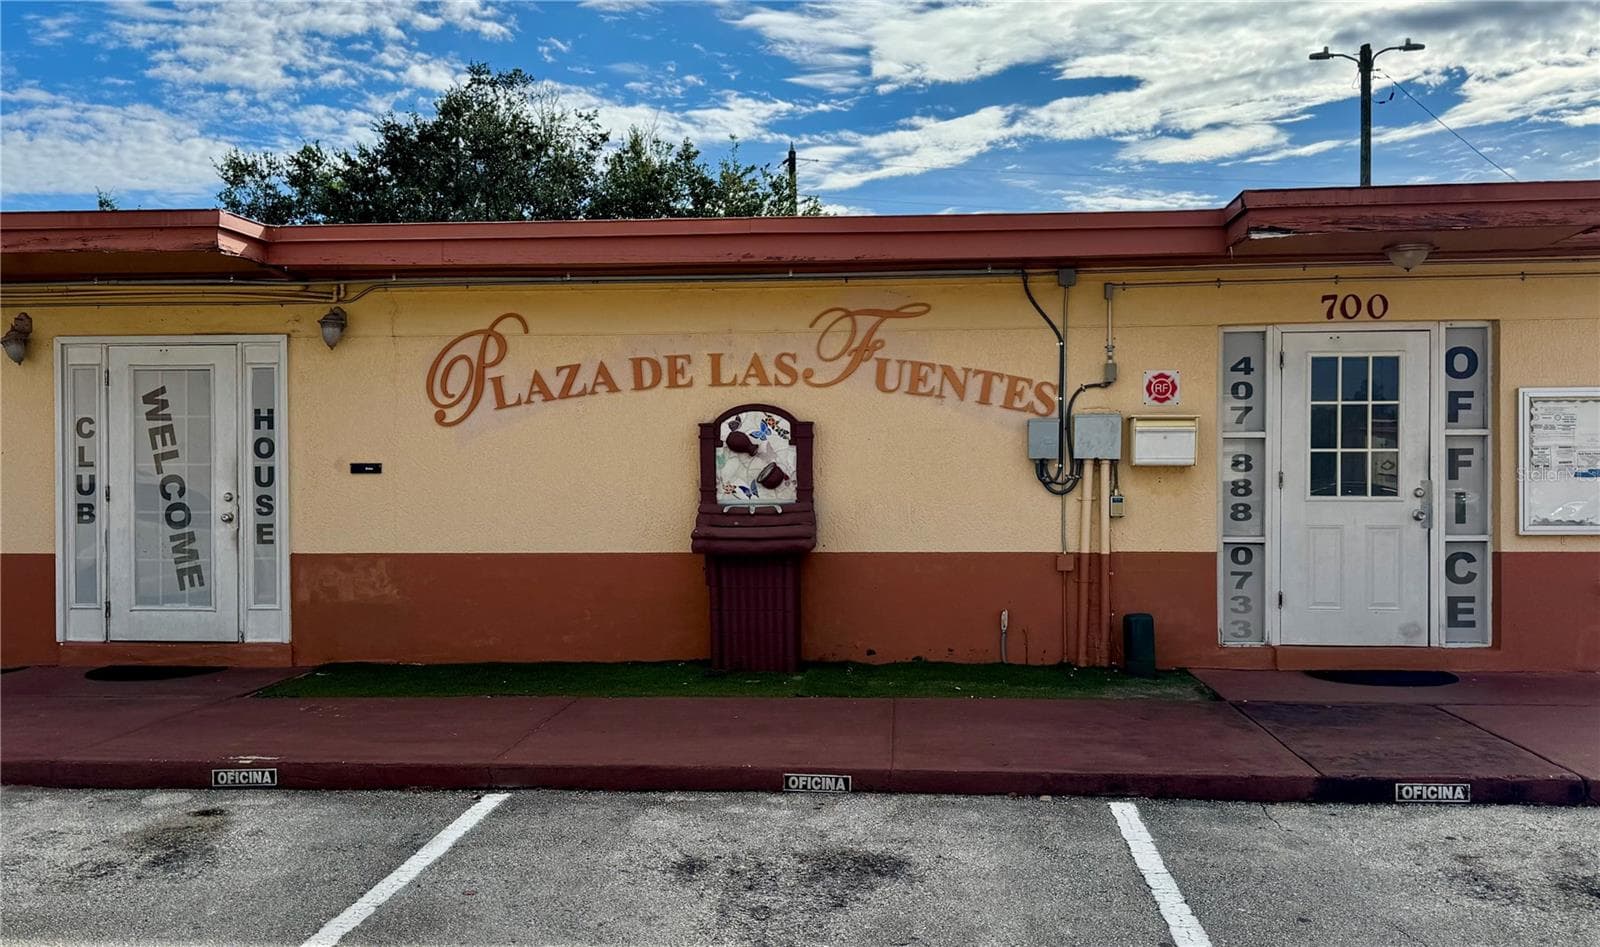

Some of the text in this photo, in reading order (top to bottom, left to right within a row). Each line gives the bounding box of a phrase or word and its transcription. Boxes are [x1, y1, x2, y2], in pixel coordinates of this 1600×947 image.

[1321, 293, 1389, 320] 700
[425, 302, 1059, 428] PLAZA DE LAS FUENTES
[1155, 383, 1169, 393] RF
[75, 416, 96, 525] CLUB
[141, 385, 205, 592] WELCOME
[253, 408, 276, 545] HOUSE
[1229, 356, 1254, 640] 407 888 0733
[1445, 346, 1478, 628] OFFICE
[217, 771, 272, 784] OFICINA
[788, 776, 846, 791] OFICINA
[1401, 785, 1465, 800] OFICINA
